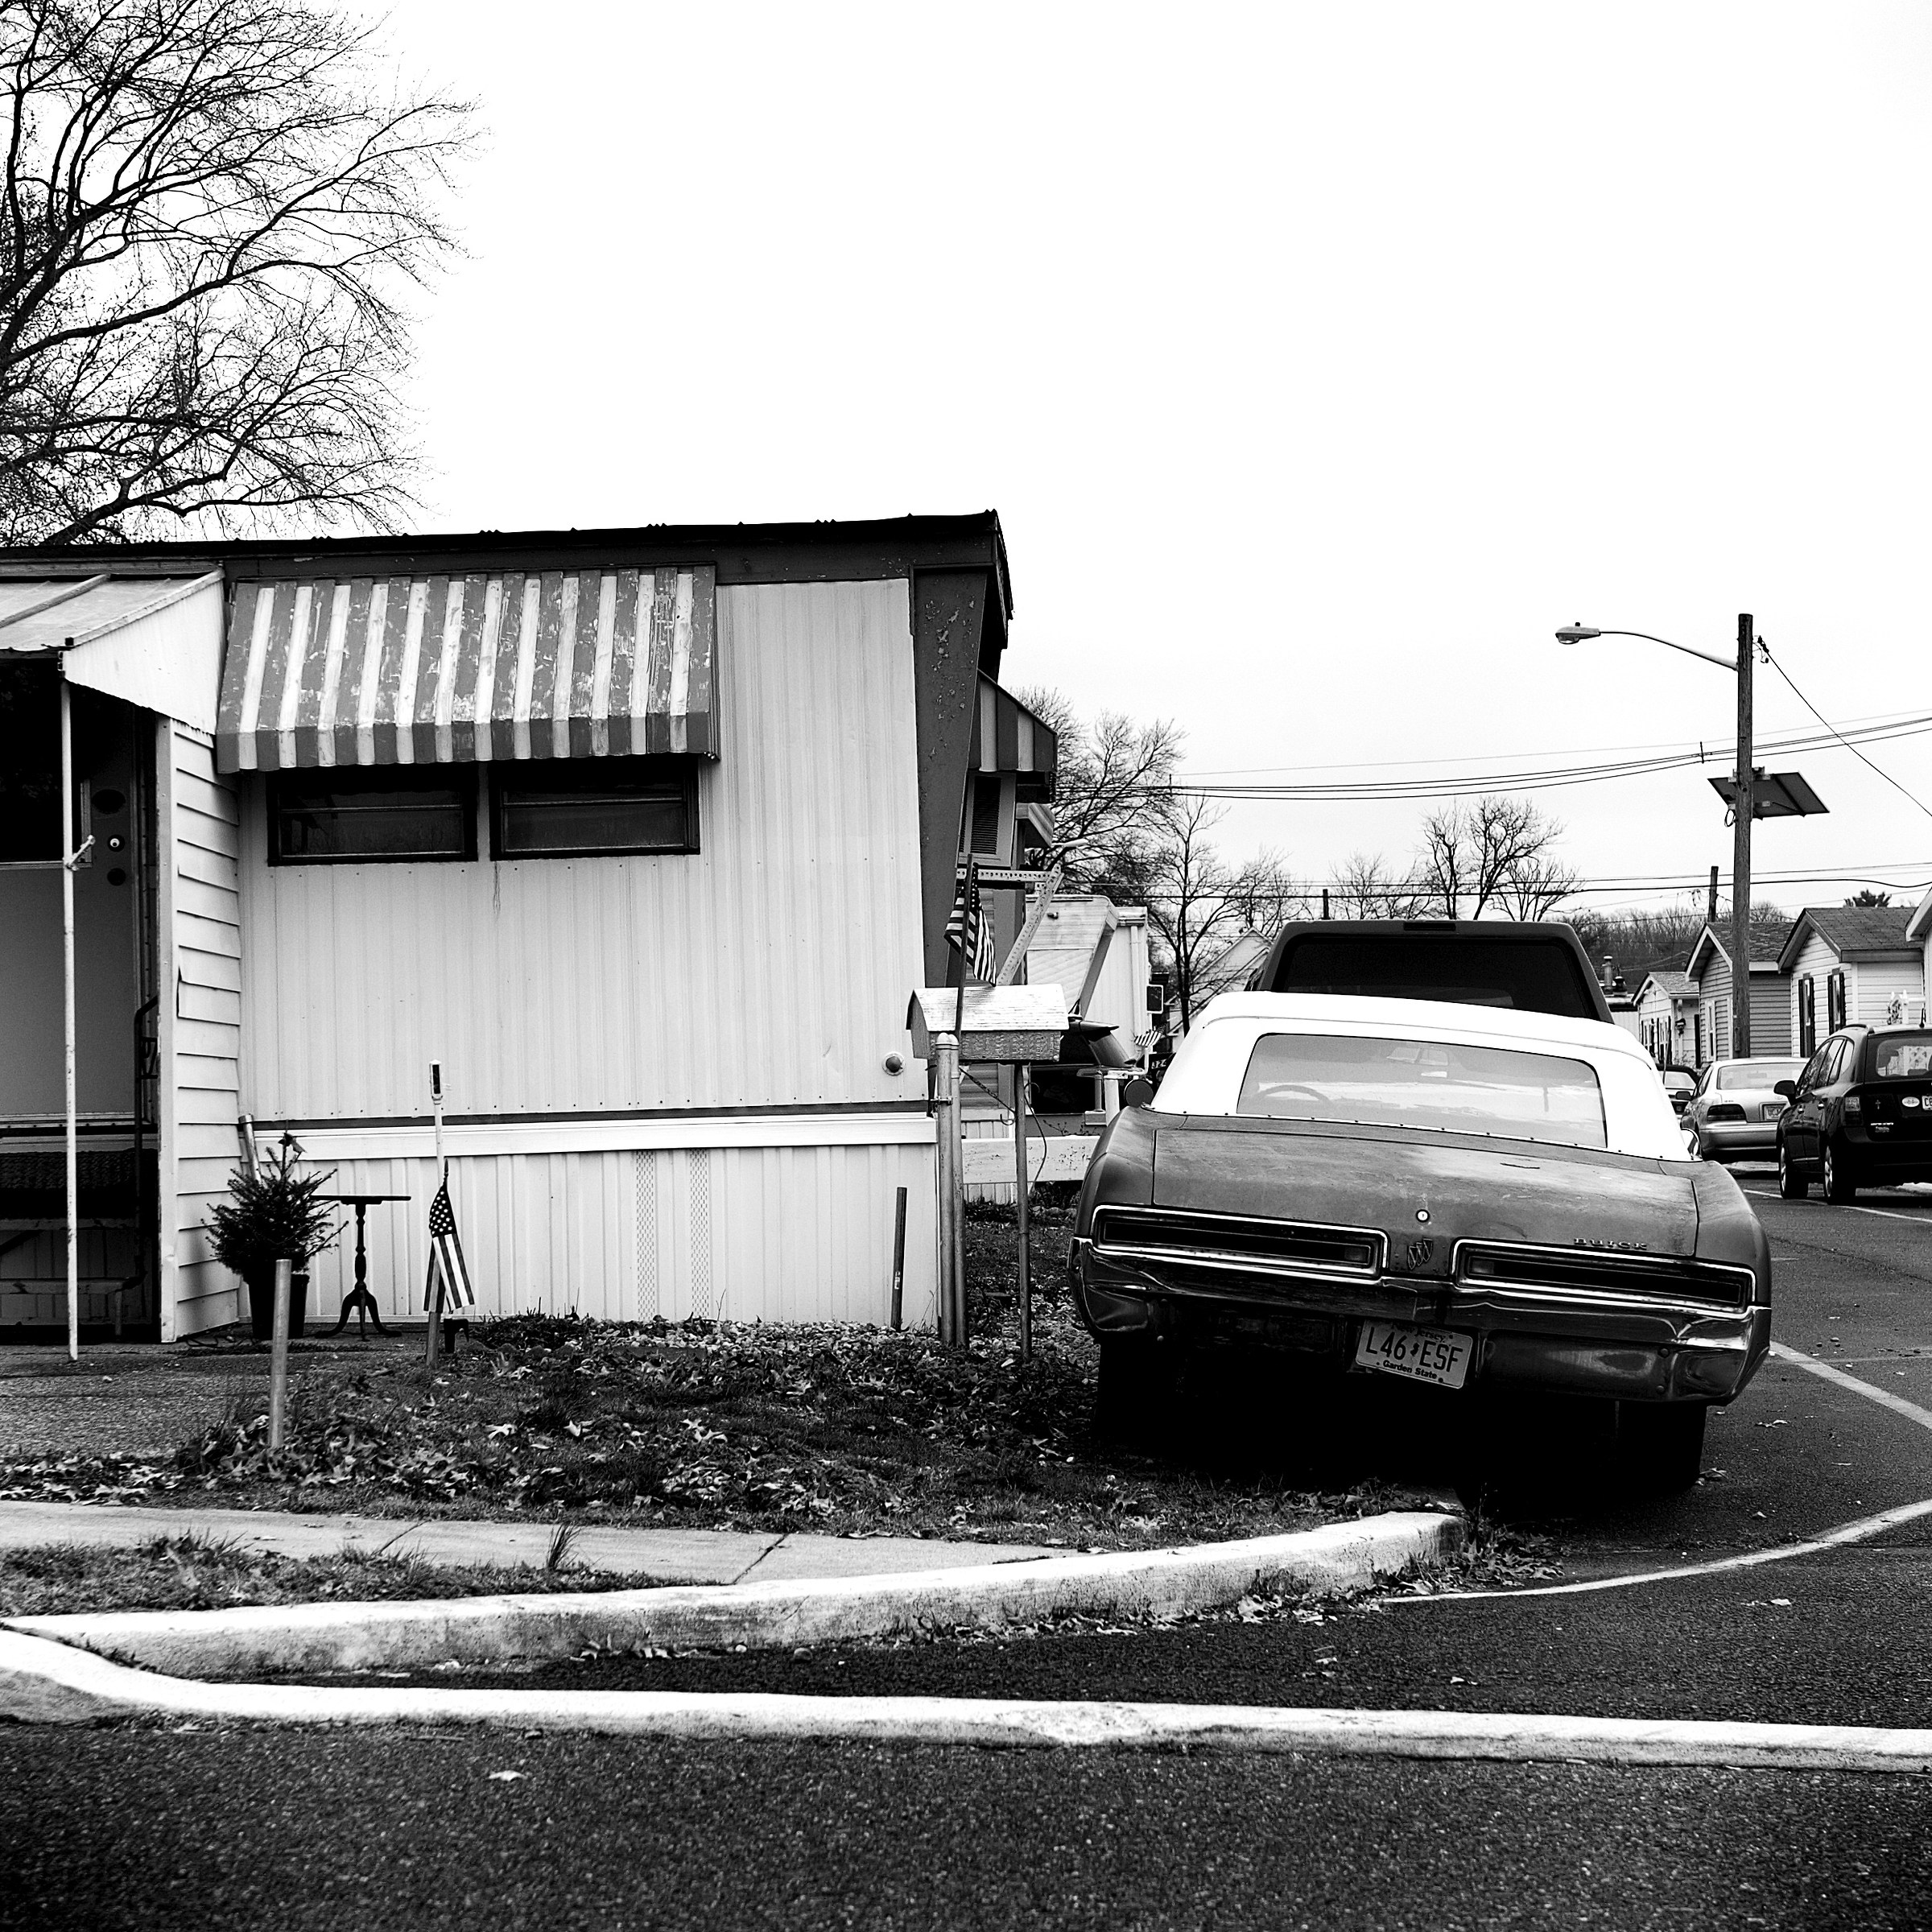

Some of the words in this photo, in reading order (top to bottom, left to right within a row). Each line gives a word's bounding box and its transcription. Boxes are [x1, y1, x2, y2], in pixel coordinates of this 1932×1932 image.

[1365, 1327, 1407, 1360] L46
[1419, 1340, 1463, 1373] ESF
[1383, 1360, 1413, 1373] Garden
[1414, 1367, 1438, 1380] State
